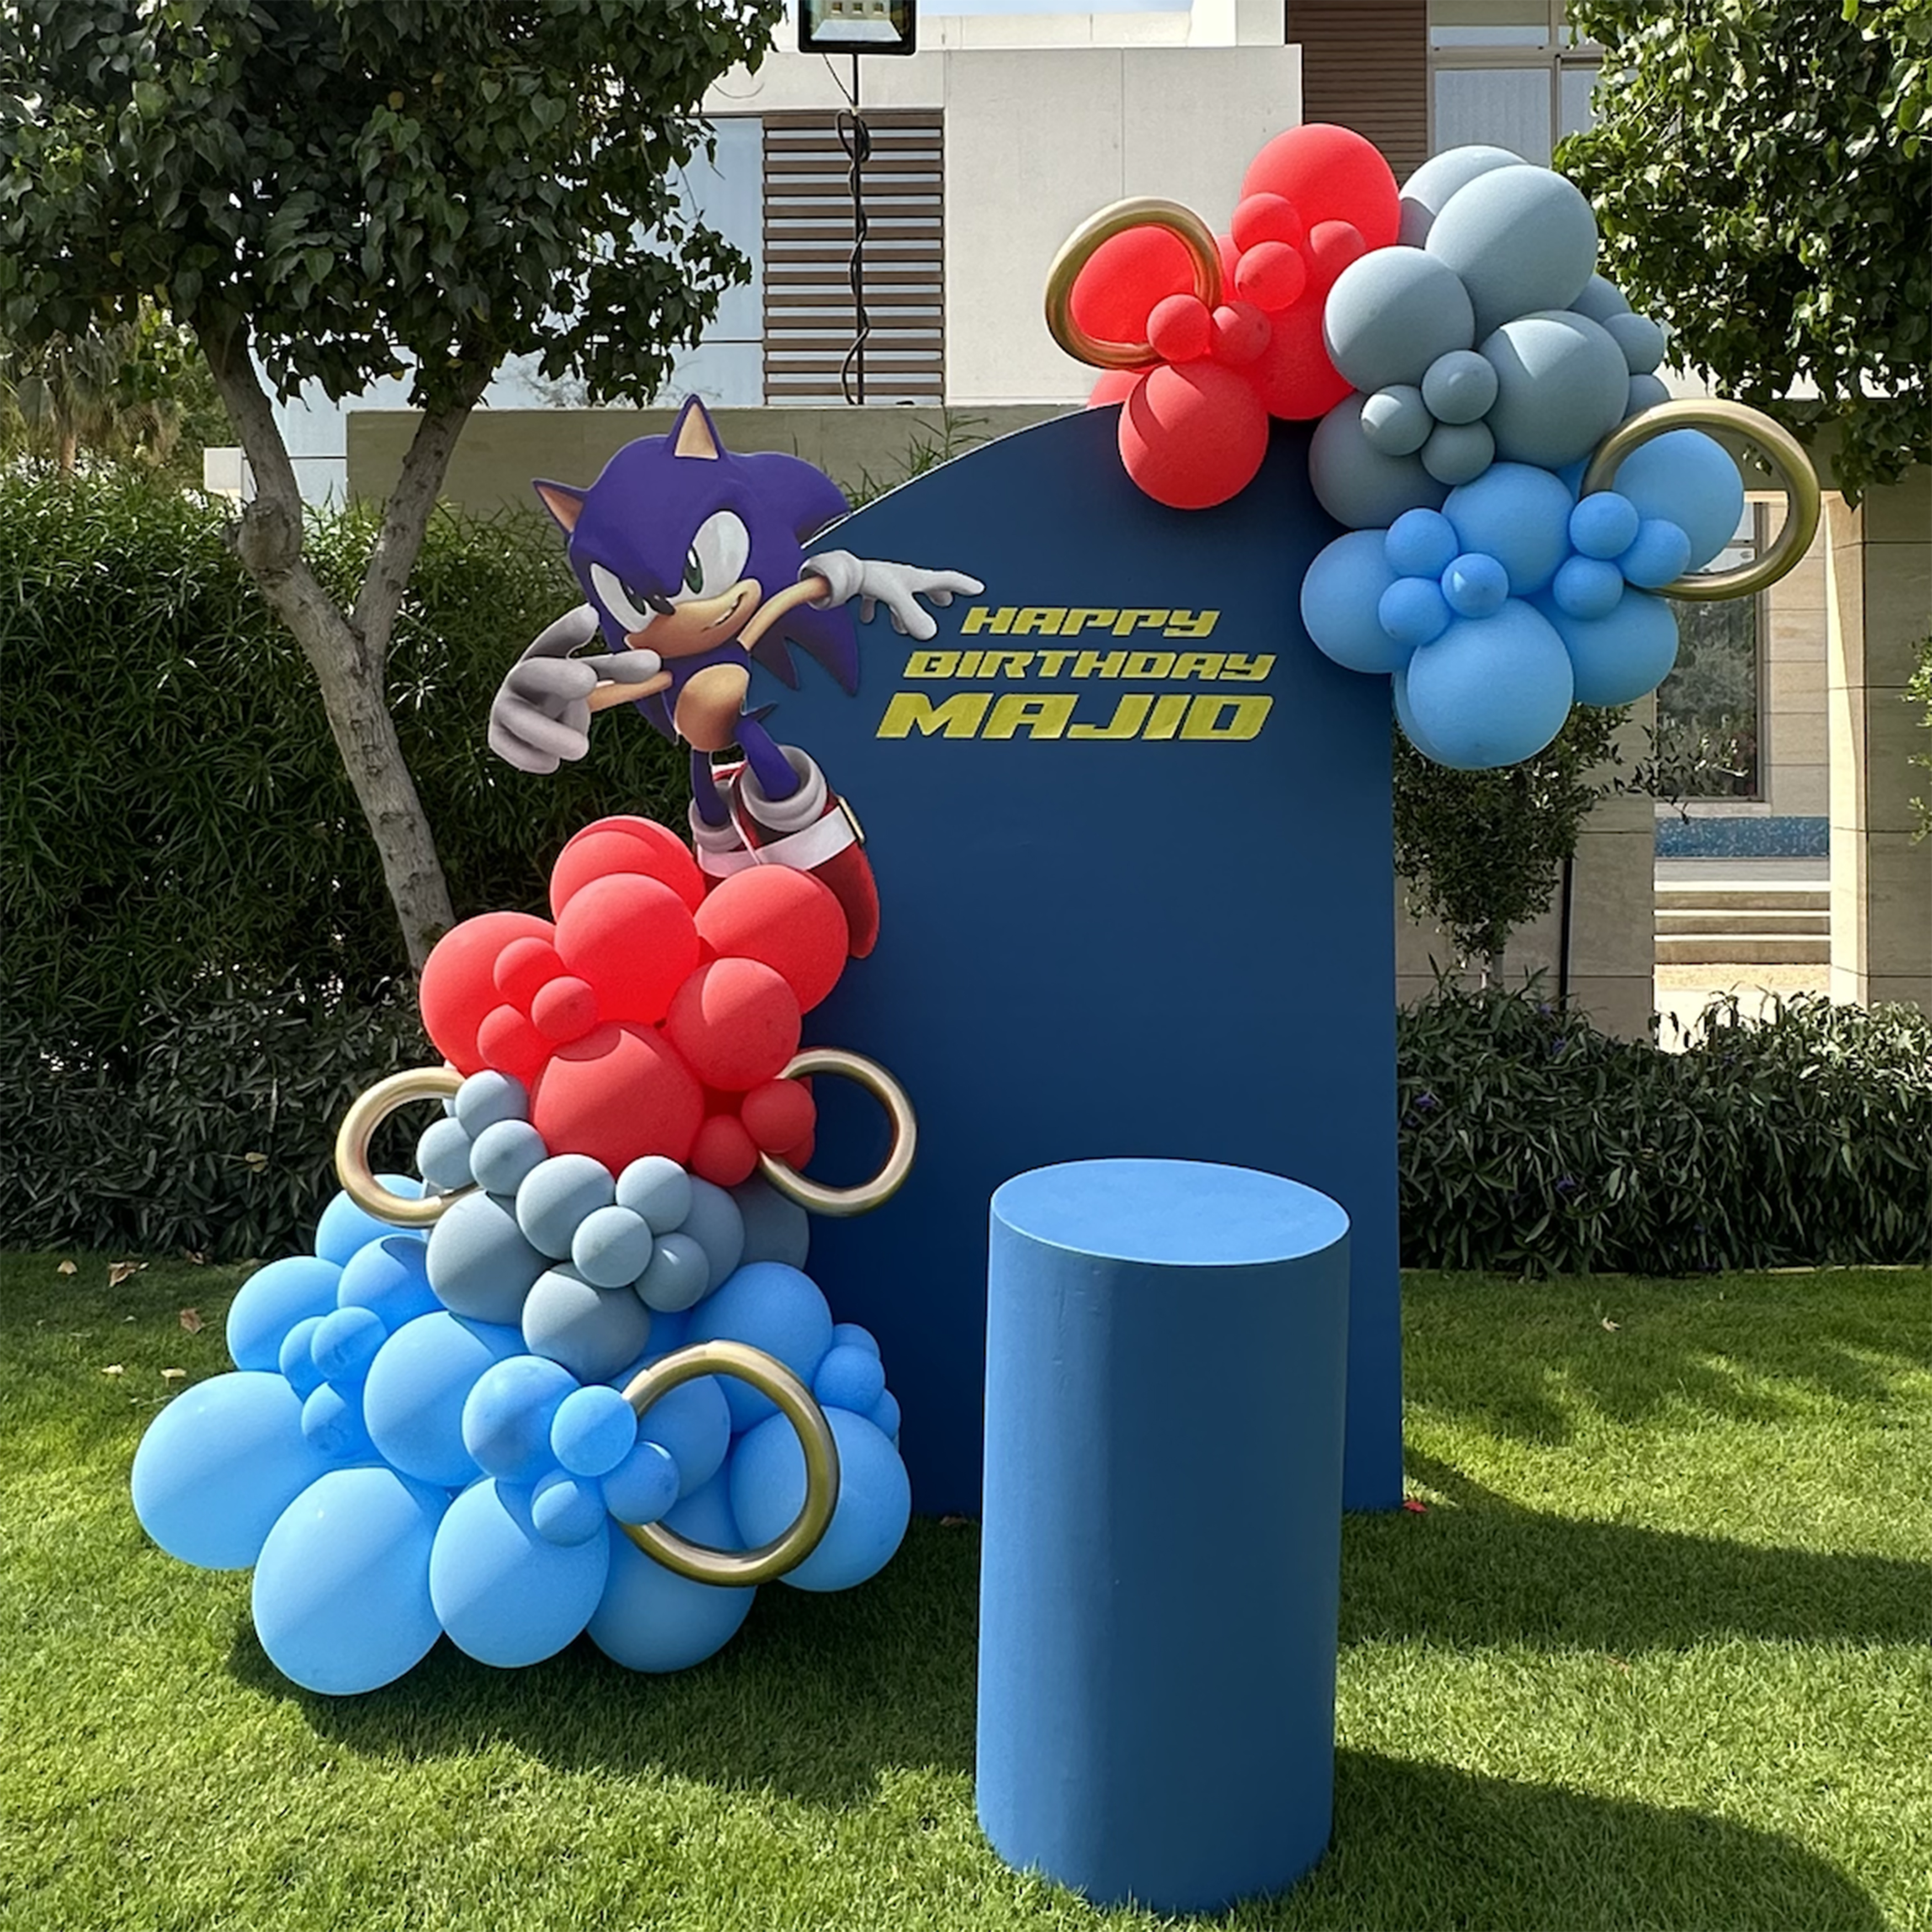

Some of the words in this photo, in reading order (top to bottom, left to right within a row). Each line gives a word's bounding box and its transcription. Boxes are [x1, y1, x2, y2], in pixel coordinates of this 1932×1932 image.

[960, 606, 1220, 637] HAPPY
[903, 650, 1276, 681] BIRTHDAY
[875, 692, 1275, 740] MAJID
